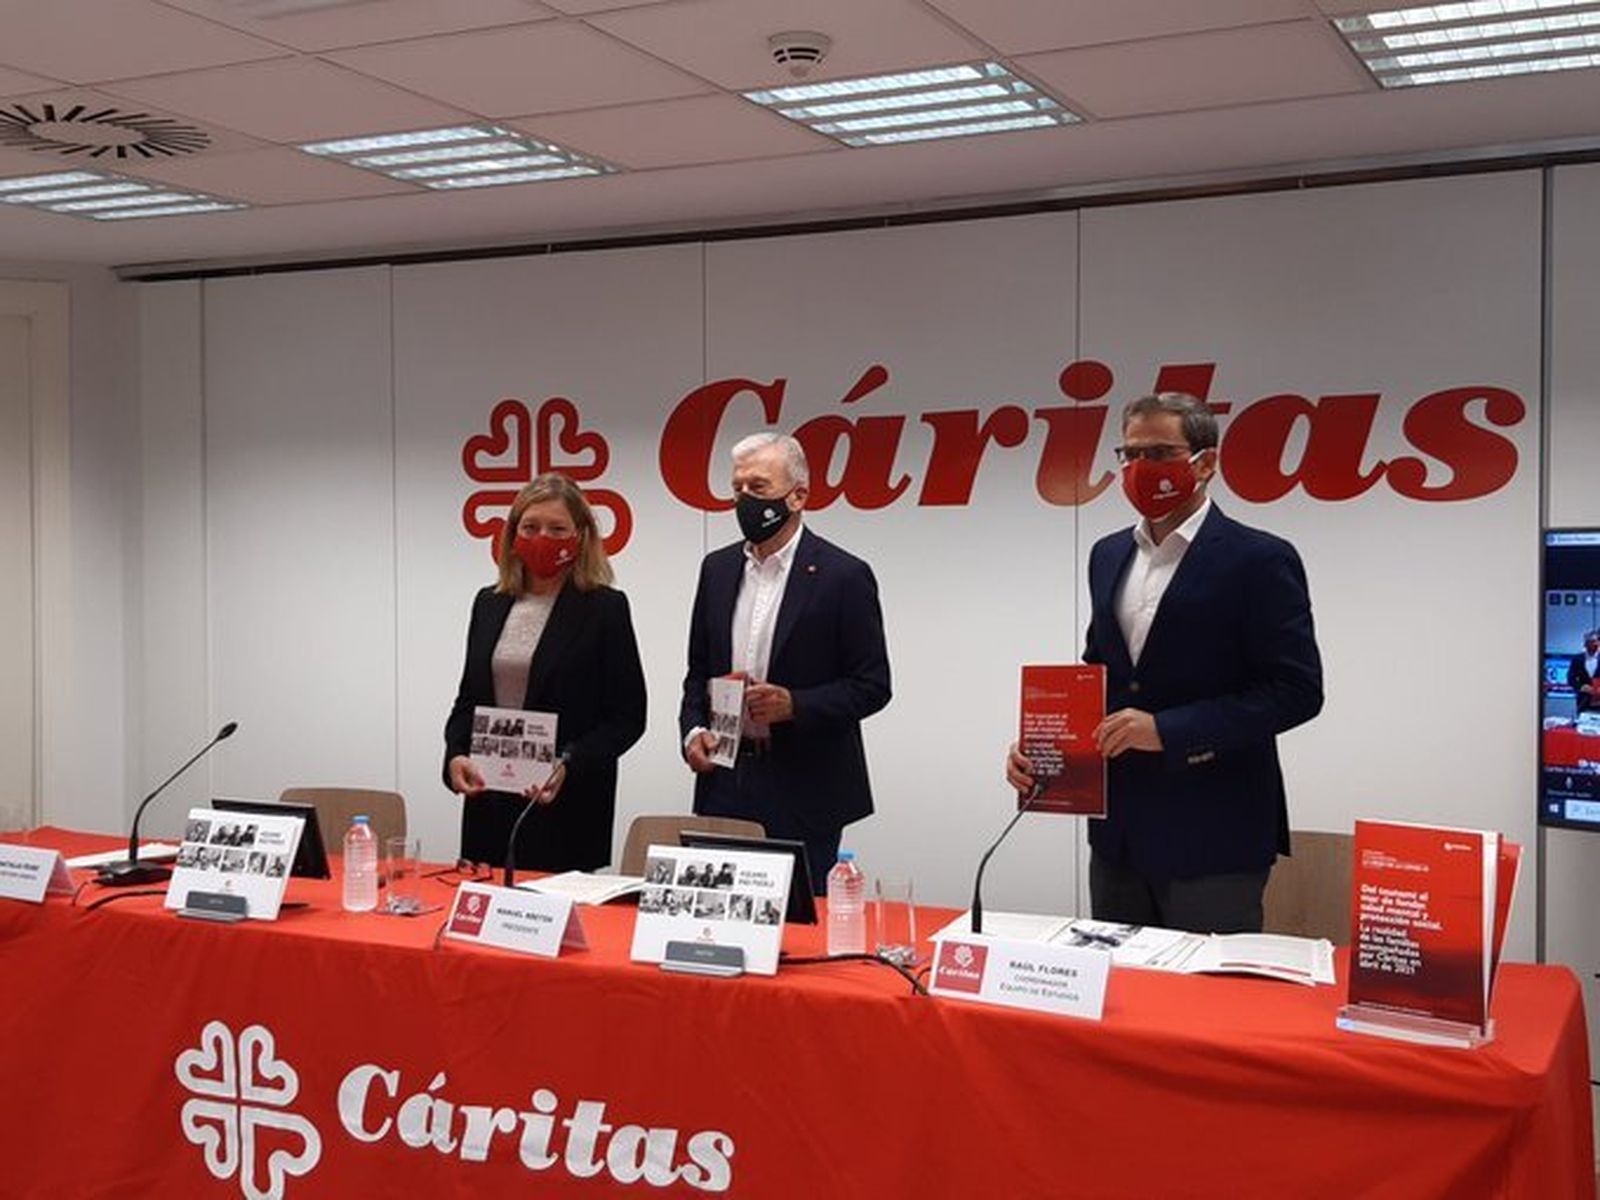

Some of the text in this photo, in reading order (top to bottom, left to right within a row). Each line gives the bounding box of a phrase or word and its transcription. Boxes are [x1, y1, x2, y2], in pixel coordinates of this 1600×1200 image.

[1009, 960, 1078, 978] RAÚL FLORES
[337, 1063, 735, 1192] Cáritas
